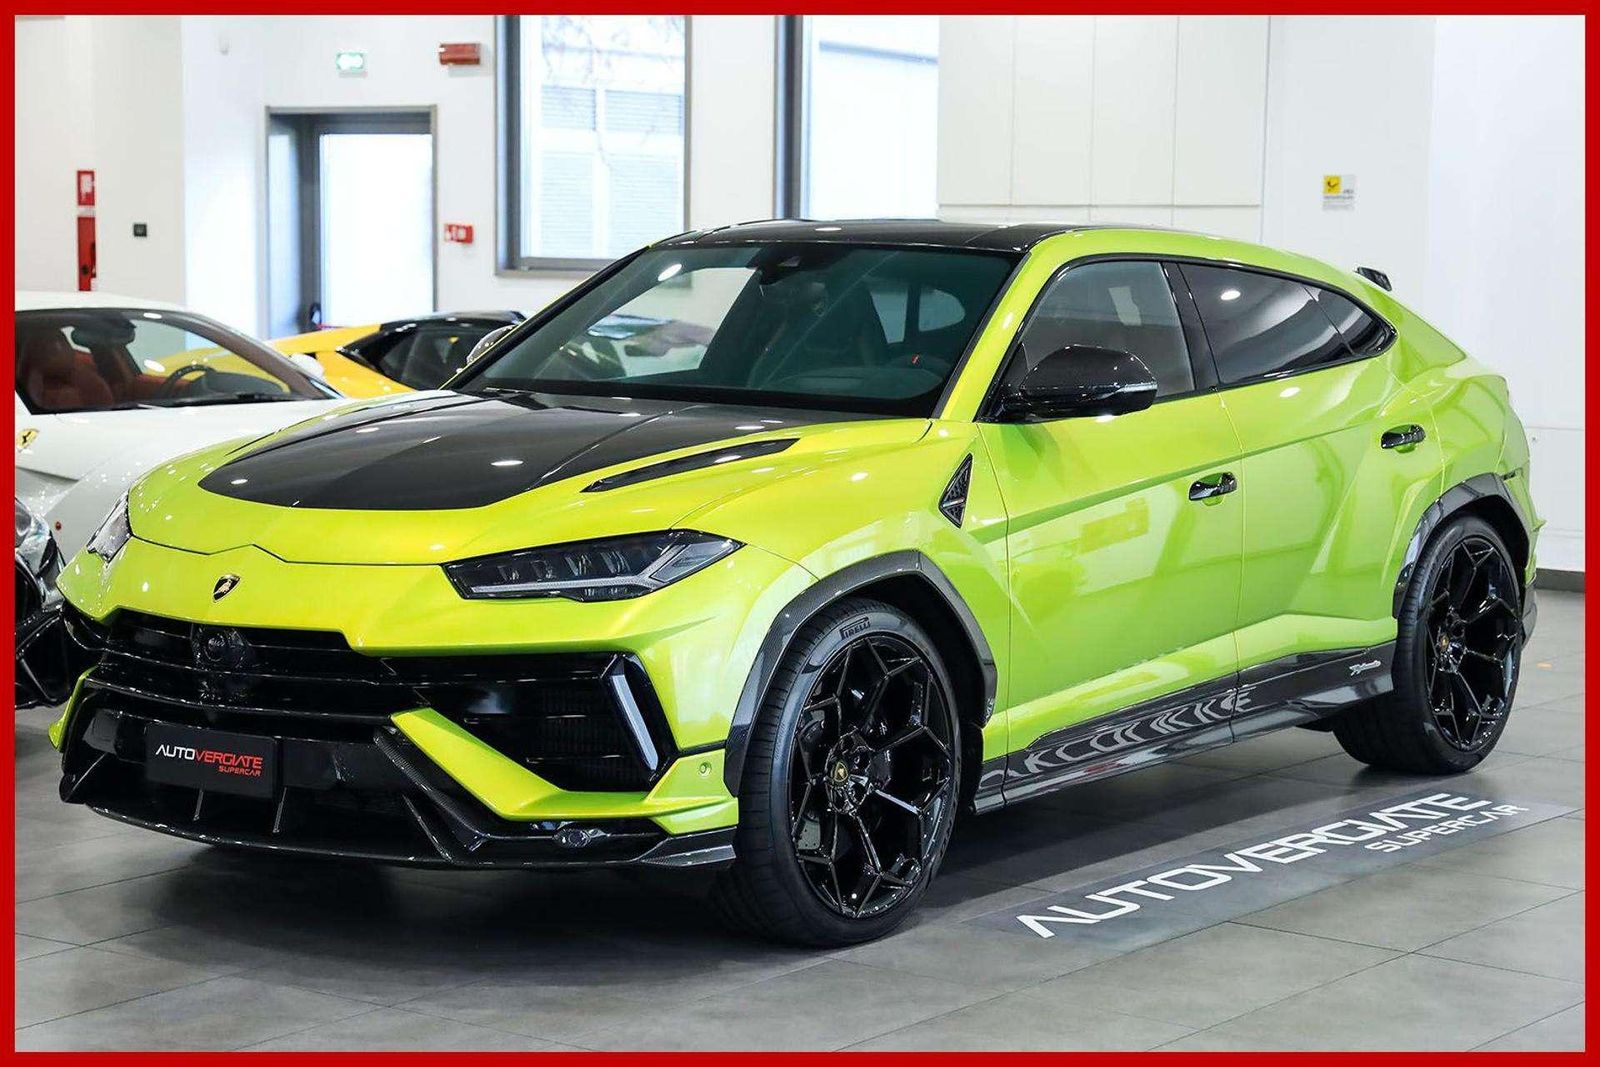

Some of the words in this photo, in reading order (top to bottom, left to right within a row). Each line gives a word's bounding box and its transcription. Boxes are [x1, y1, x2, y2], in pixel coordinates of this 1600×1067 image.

[155, 744, 263, 769] AUTOVERGIATE
[218, 765, 262, 777] SUPERCAR
[1364, 804, 1530, 854] SUPERCAR
[1015, 793, 1493, 939] AUTOVERGIATE
